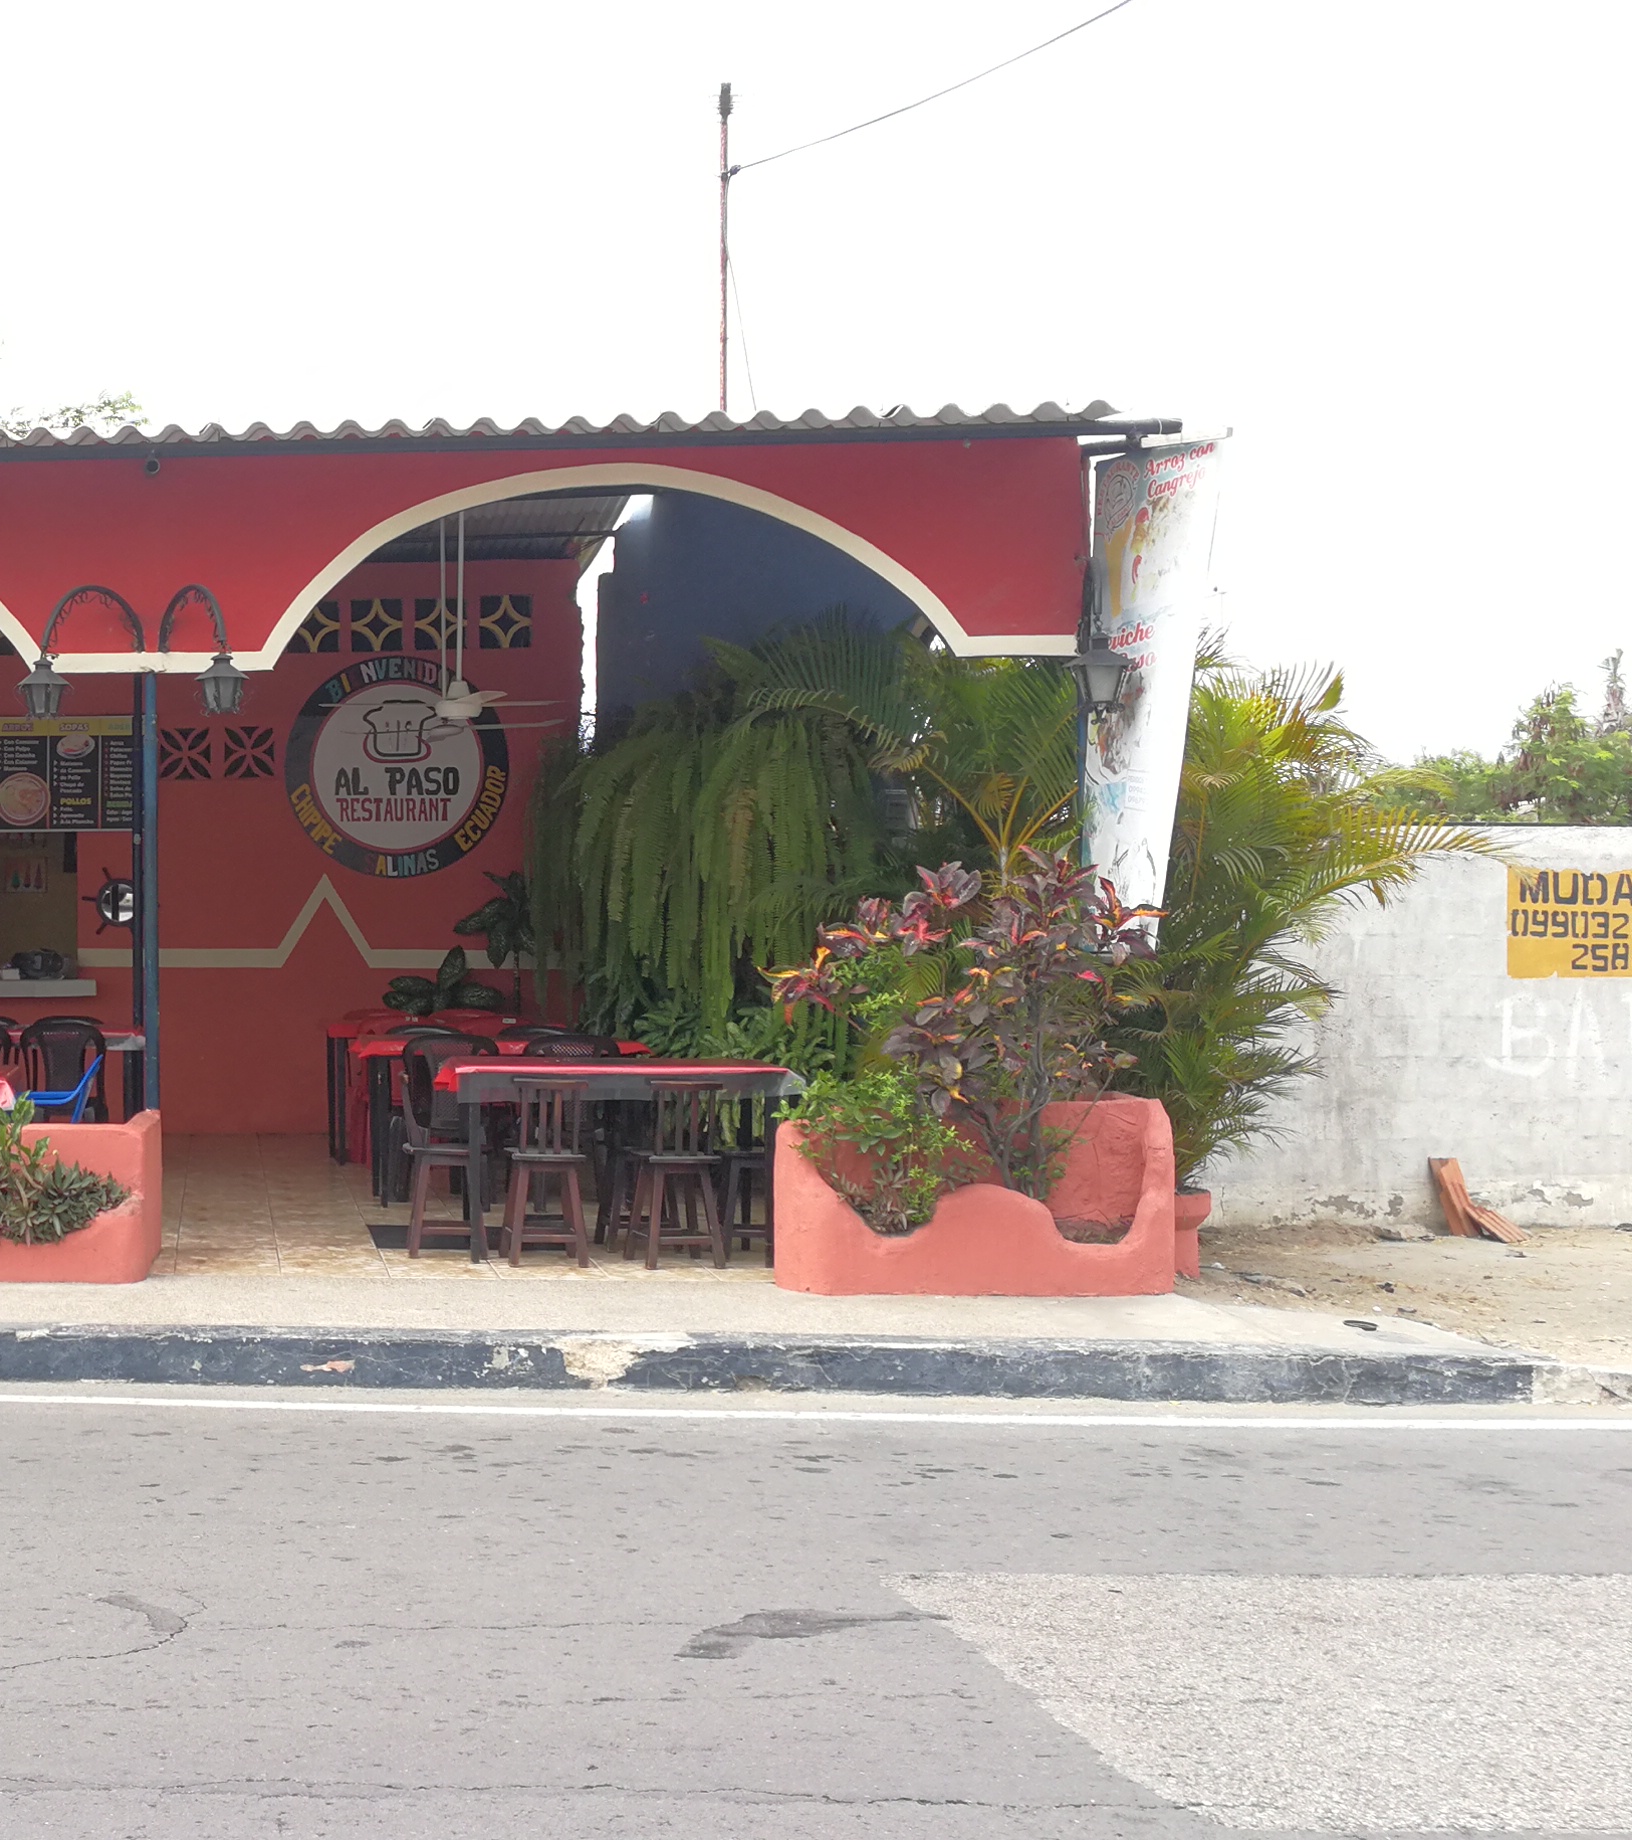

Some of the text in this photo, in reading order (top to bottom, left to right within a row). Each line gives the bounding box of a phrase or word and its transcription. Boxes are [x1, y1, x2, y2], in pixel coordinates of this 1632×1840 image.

[1143, 442, 1216, 479] Arroz con
[1147, 463, 1206, 499] Cangrejo
[1108, 621, 1155, 650] viche
[59, 723, 89, 732] SOPAS
[335, 767, 461, 796] AL PASO
[335, 797, 452, 822] RESTAURANT
[454, 765, 507, 852] ECUADOR
